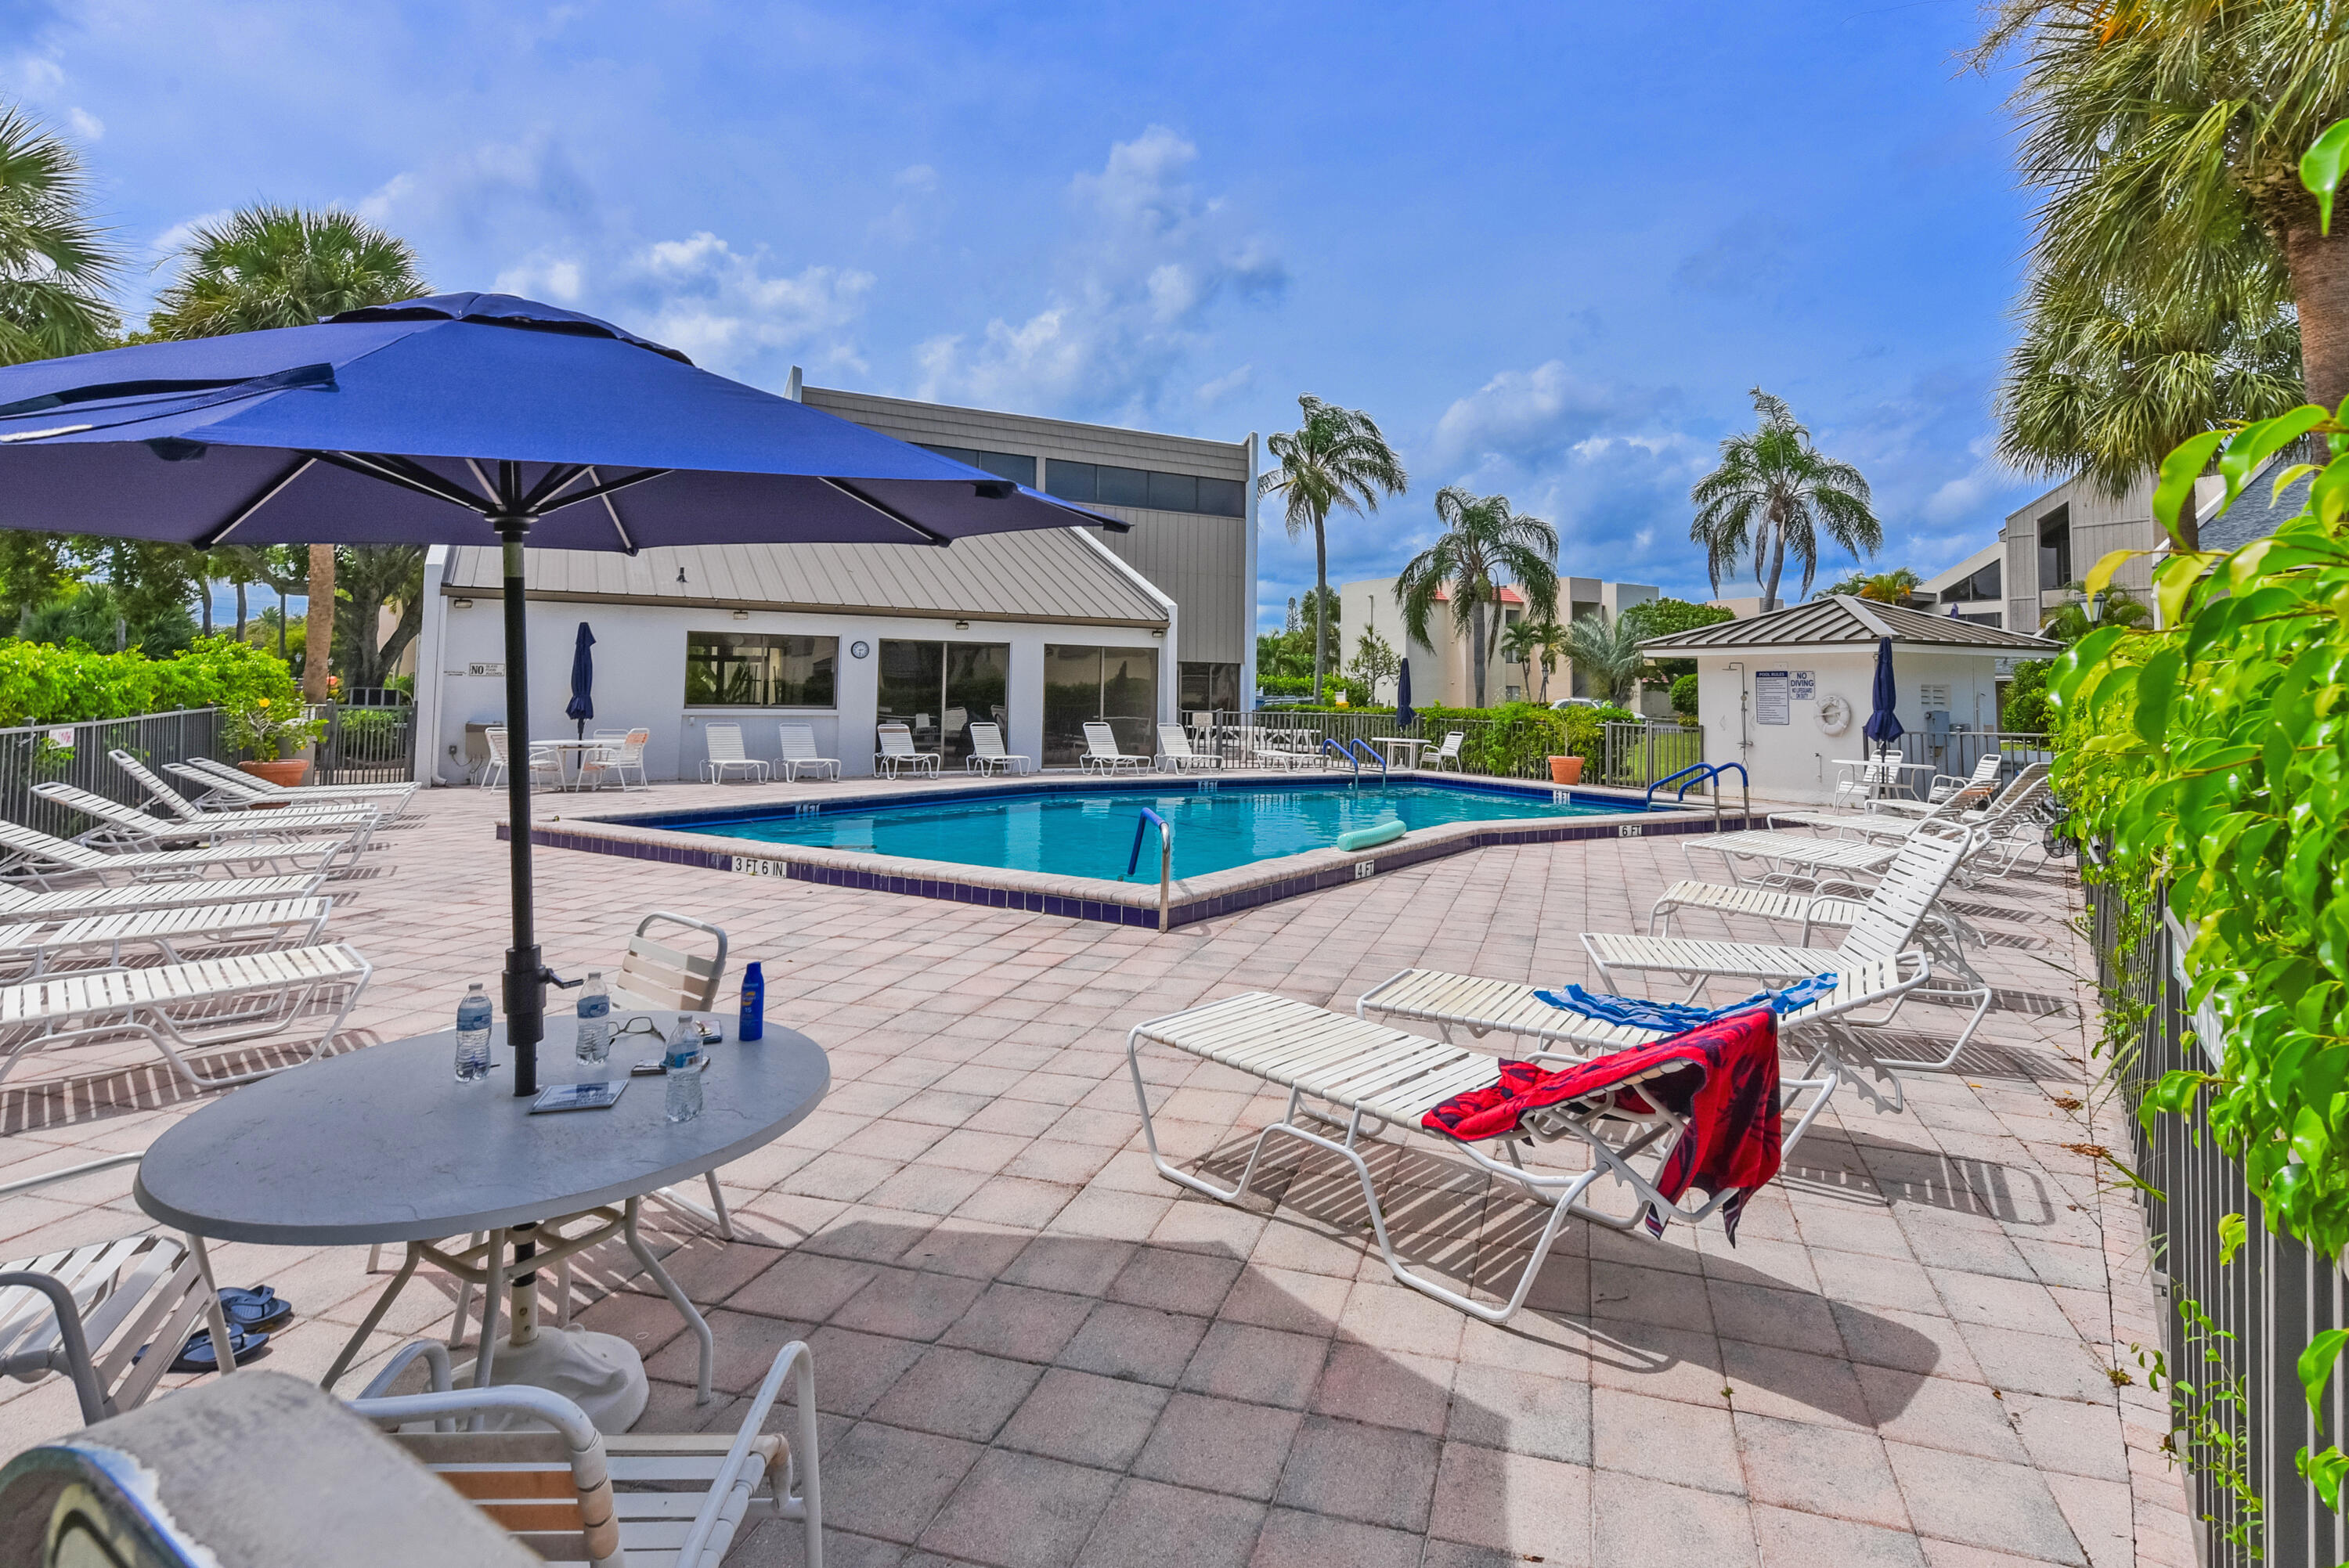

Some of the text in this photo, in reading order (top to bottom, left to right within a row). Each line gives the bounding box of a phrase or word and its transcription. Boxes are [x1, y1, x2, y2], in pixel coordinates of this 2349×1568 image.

[471, 665, 484, 675] NO
[1622, 826, 1628, 837] 6
[735, 857, 742, 871] 3
[762, 860, 769, 875] 6
[773, 861, 785, 878] IN.
[1358, 863, 1362, 878] 4
